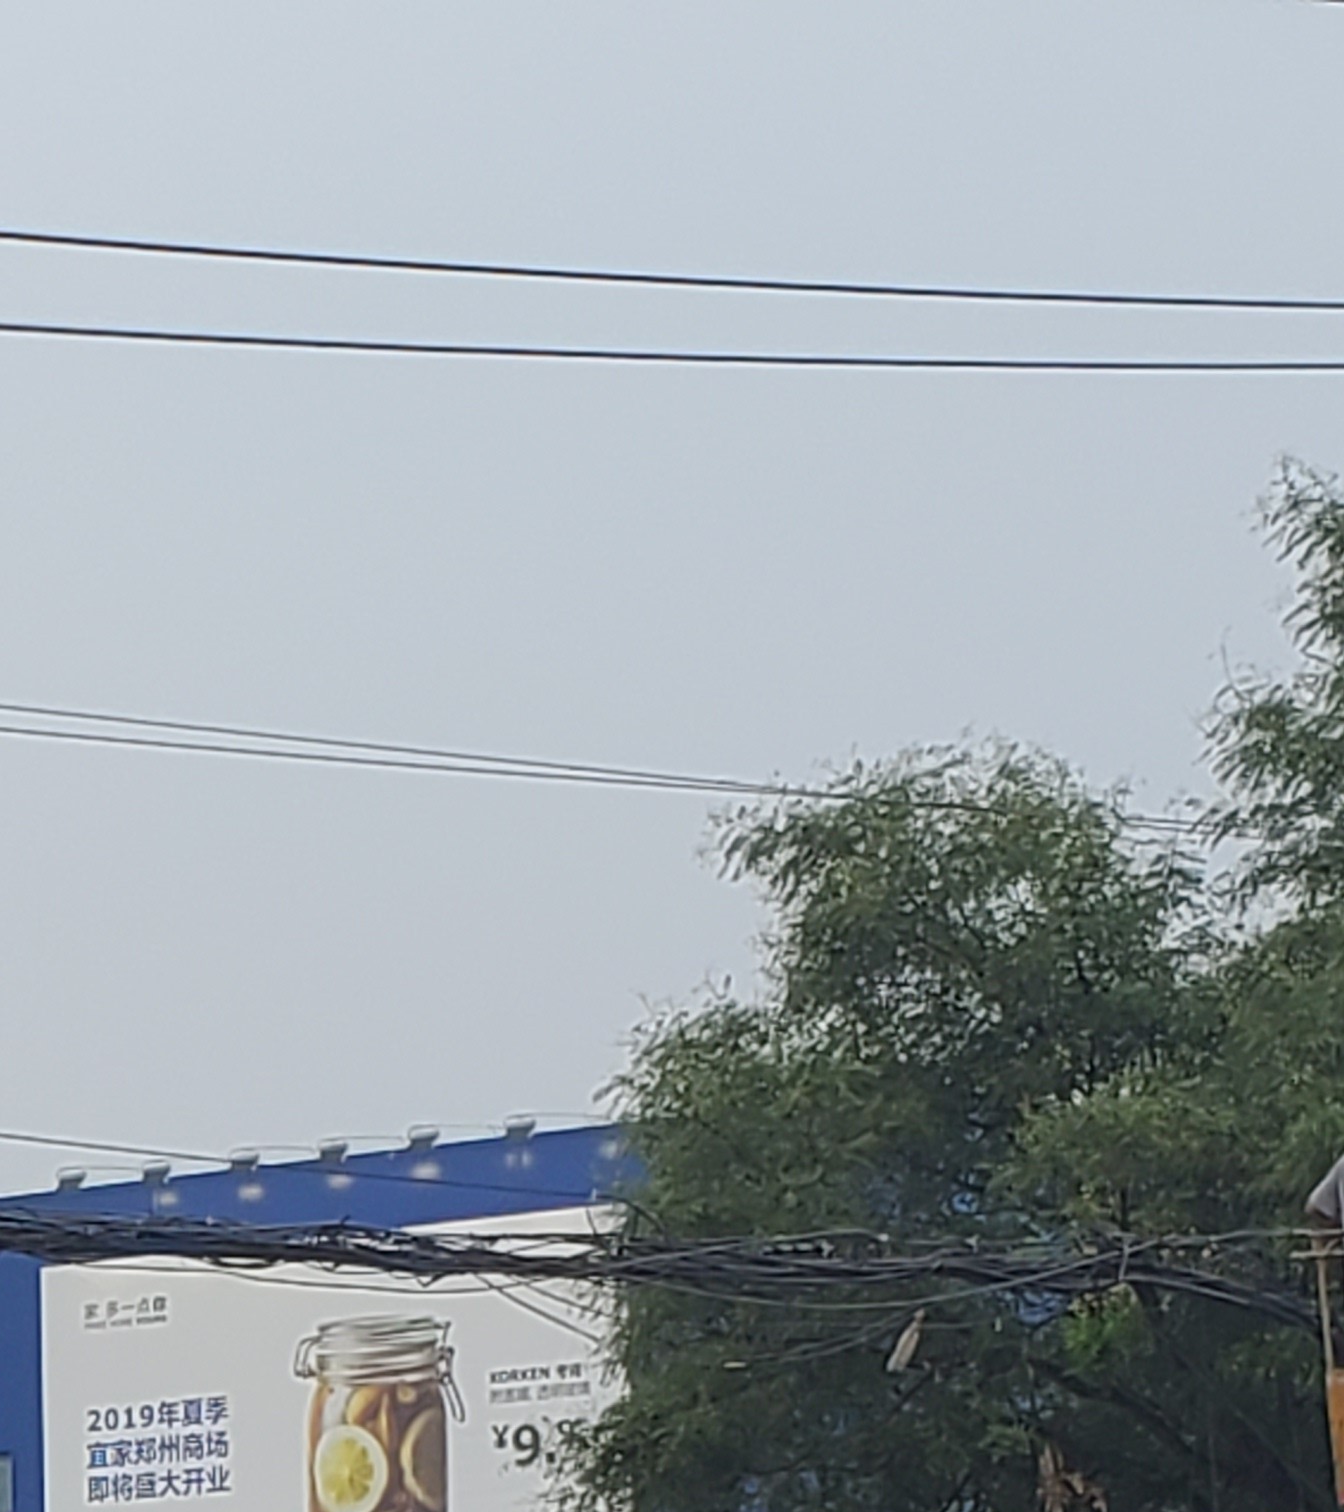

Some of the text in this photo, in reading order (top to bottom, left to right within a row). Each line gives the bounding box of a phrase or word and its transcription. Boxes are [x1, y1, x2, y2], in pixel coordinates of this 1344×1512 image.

[87, 1396, 229, 1432] 2019年夏季
[86, 1431, 229, 1469] 宜家郑州商场
